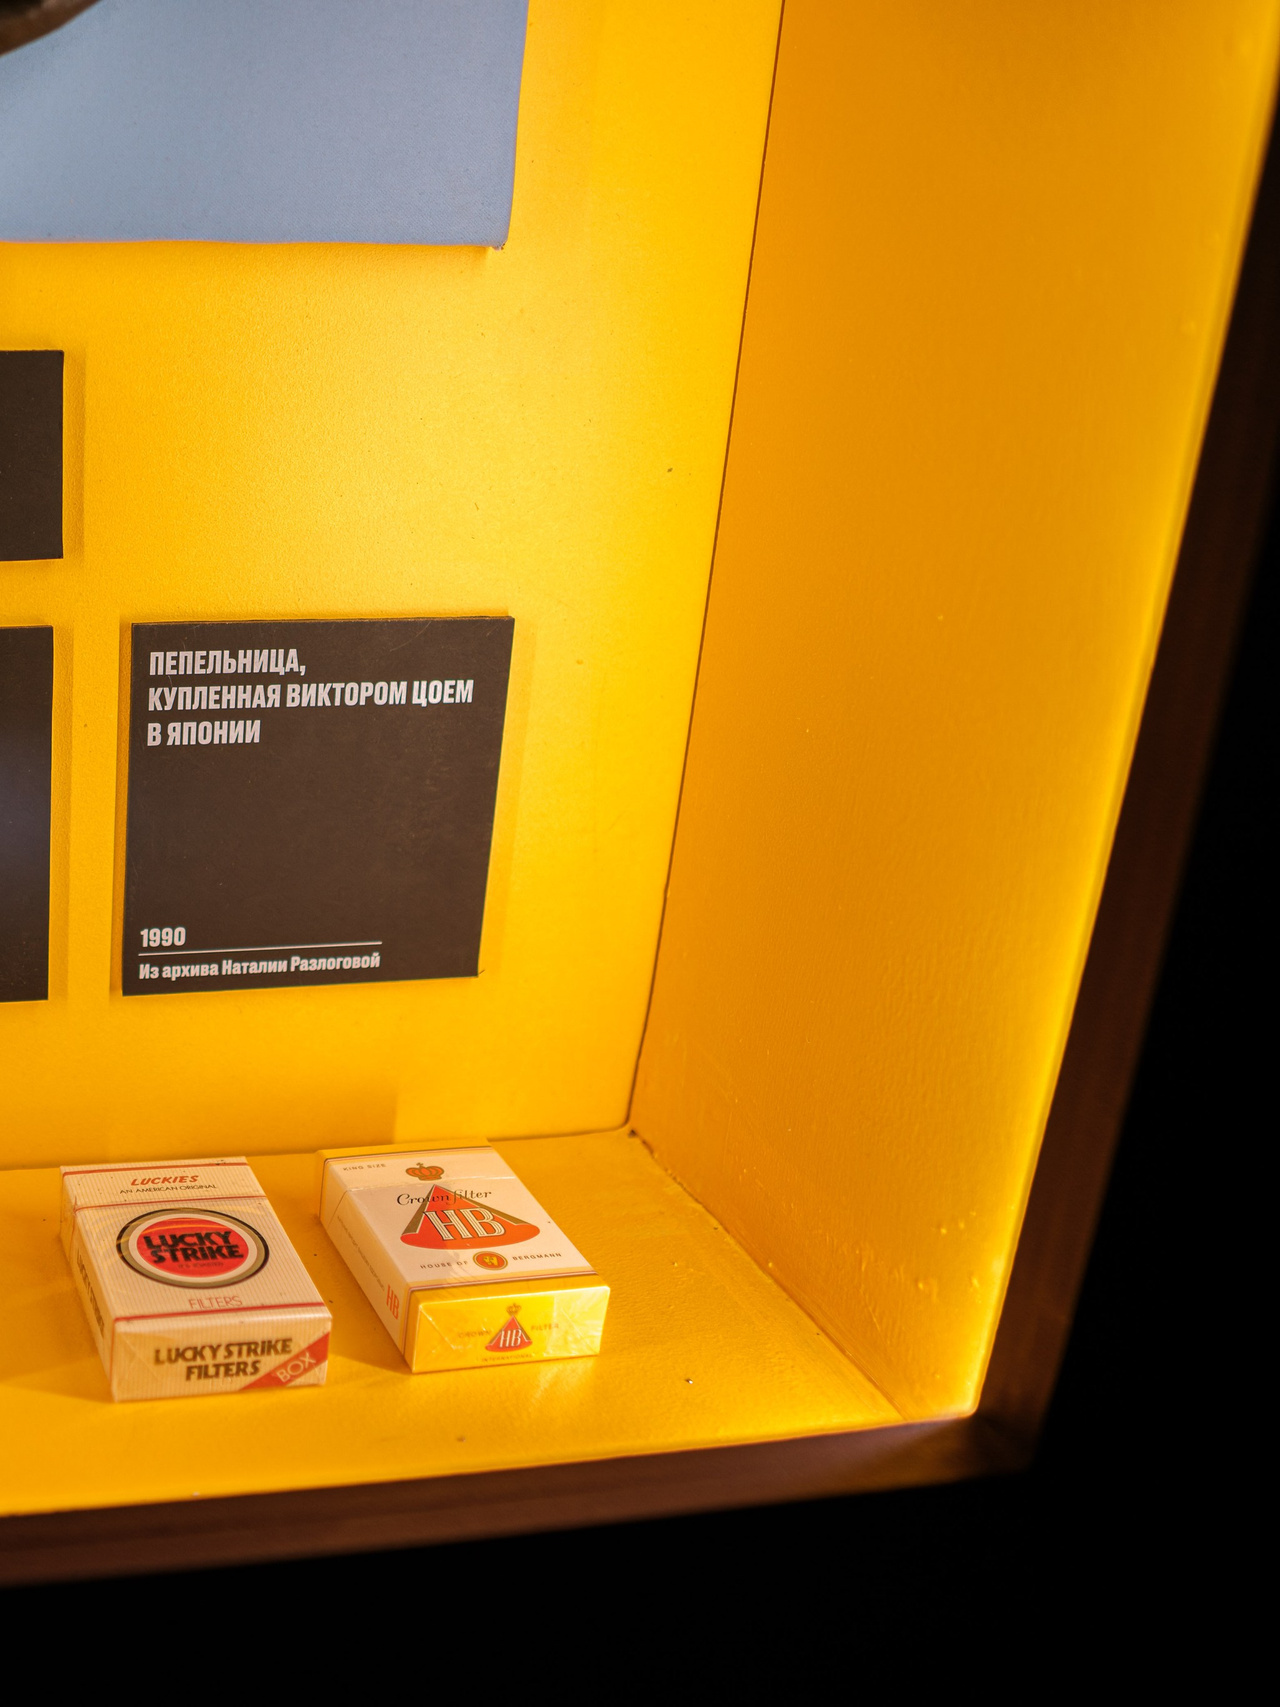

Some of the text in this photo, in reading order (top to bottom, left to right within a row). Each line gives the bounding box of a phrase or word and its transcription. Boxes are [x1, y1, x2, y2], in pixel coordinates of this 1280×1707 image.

[149, 648, 307, 677] ПЕПЕЛЬНИЦА,
[148, 679, 475, 712] КУПЛЕННАЯ ВИКТОРОМ ЦОЕМ
[146, 719, 261, 747] В ЯПОНИИ
[140, 926, 187, 948] 1990
[139, 952, 380, 982] Из архива Наталии Разлоговой
[130, 1175, 199, 1186] LUCKIES
[396, 1189, 492, 1206] Crown filter
[423, 1207, 506, 1241] HB
[143, 1231, 231, 1250] LUCKY
[150, 1244, 244, 1264] STRIKE
[512, 1252, 562, 1261] BERGMANN
[188, 1296, 242, 1309] FILTERS
[386, 1284, 400, 1320] HB
[499, 1328, 523, 1348] HB
[154, 1338, 293, 1366] LUCKY STRIKE
[185, 1360, 262, 1381] FILTERS
[276, 1351, 317, 1383] BOX
